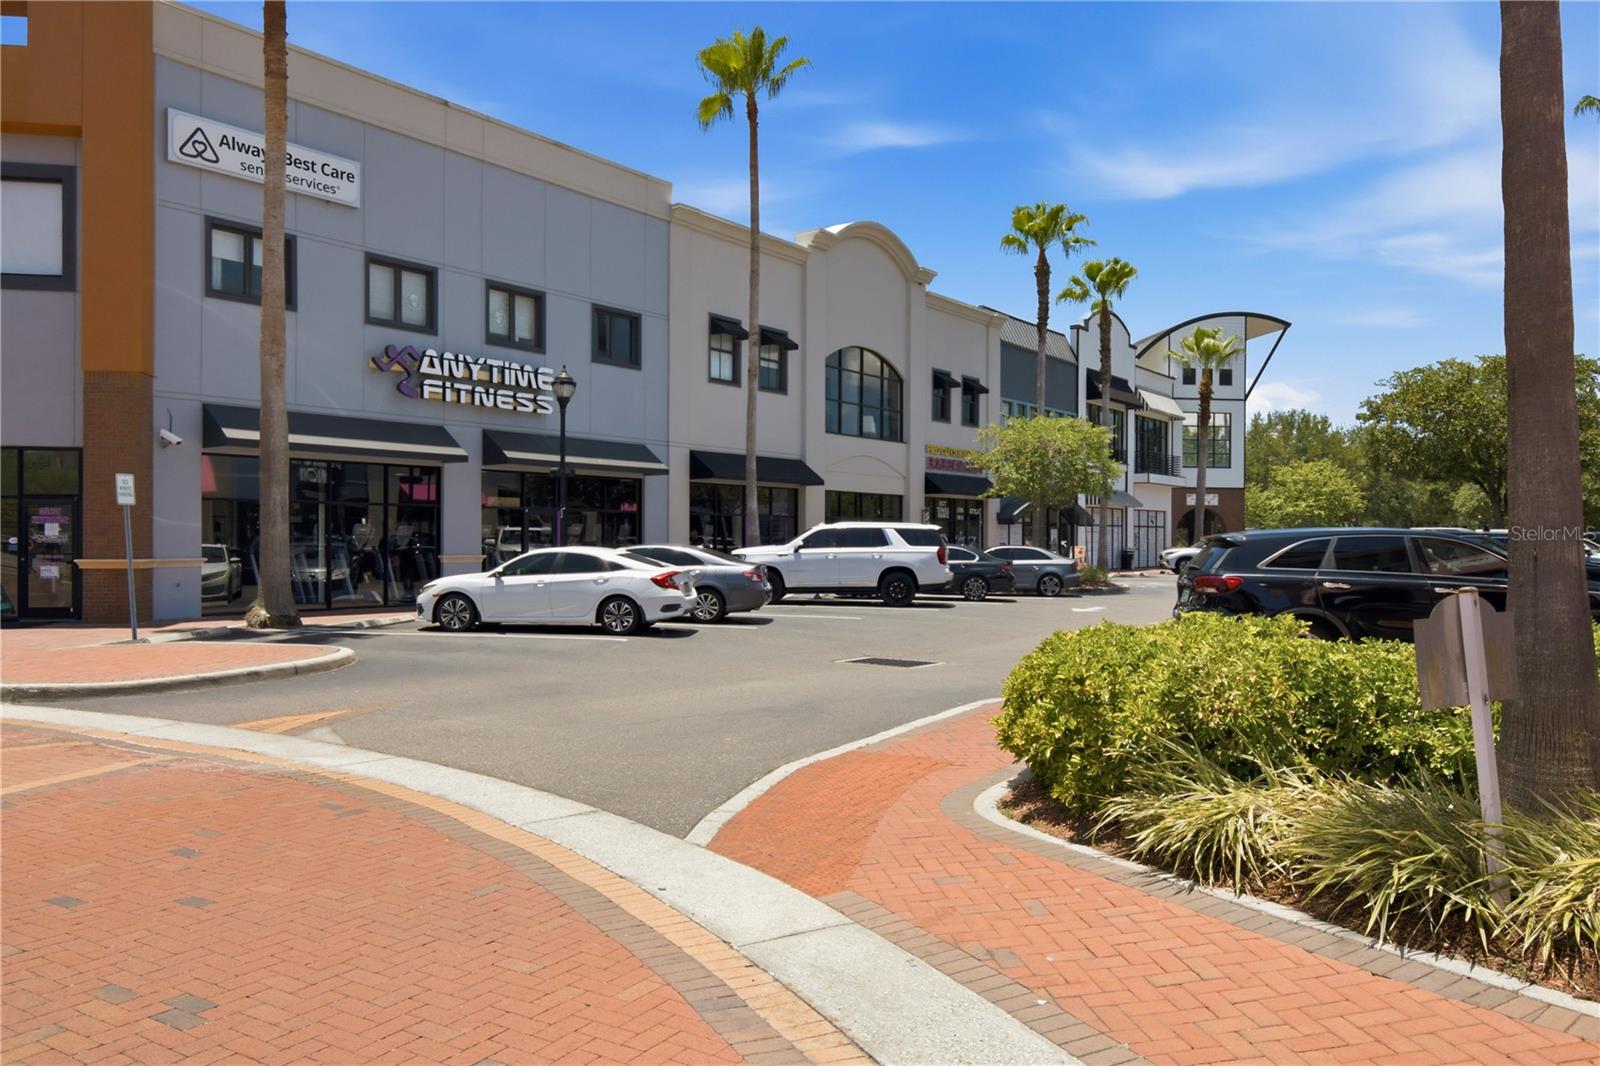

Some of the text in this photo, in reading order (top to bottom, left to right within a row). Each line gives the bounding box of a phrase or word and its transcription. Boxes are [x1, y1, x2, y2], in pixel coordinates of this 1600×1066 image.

[219, 134, 356, 184] Alway Best Care
[286, 173, 338, 195] services
[419, 348, 555, 391] ANYTIME
[421, 379, 554, 415] FITNESS
